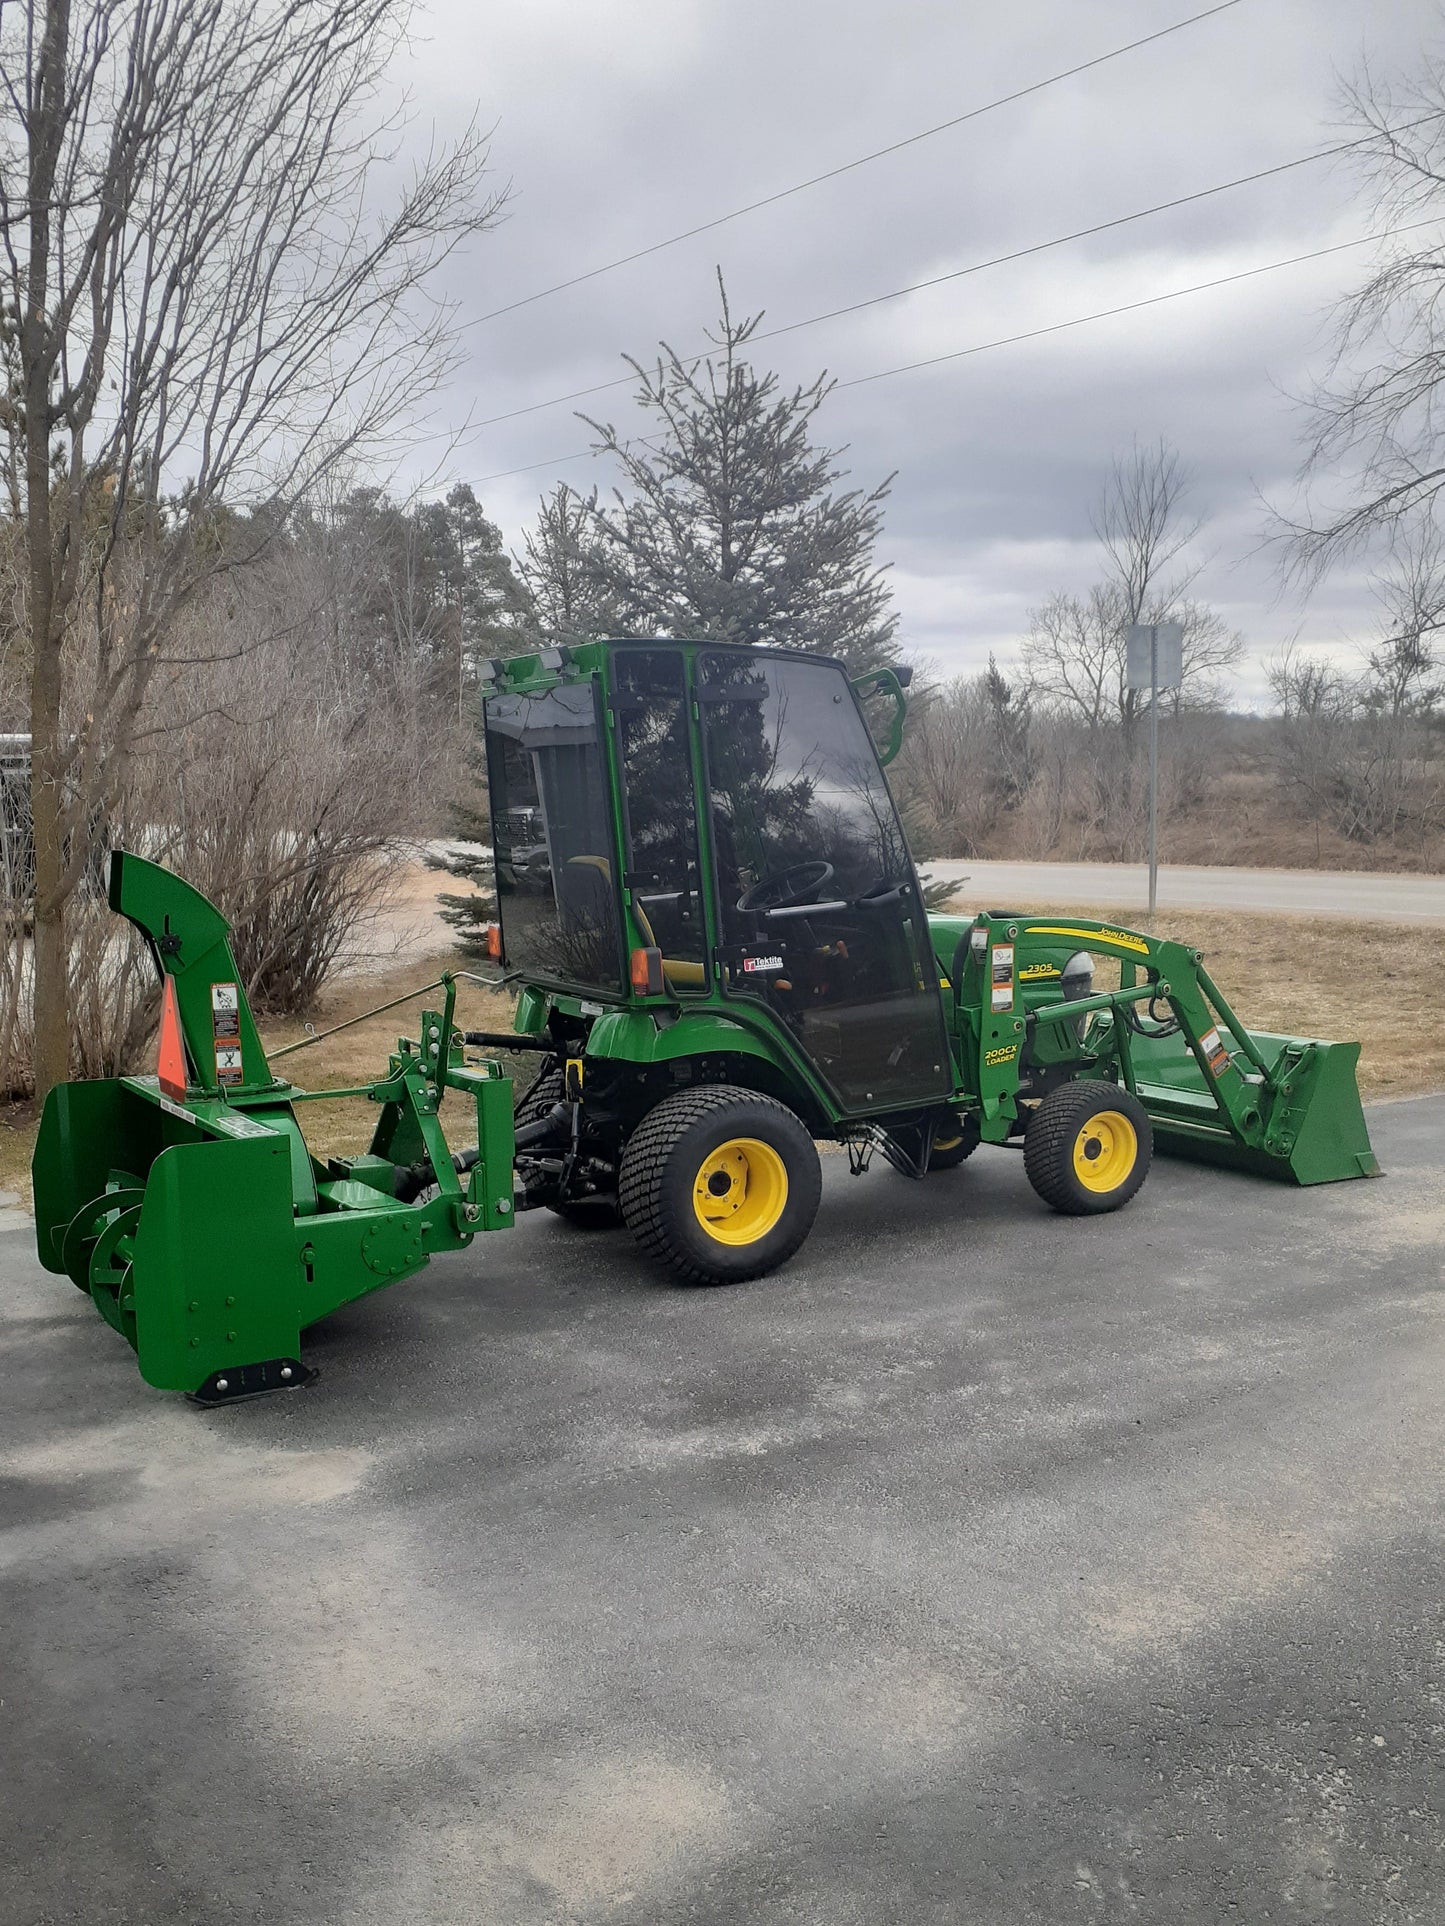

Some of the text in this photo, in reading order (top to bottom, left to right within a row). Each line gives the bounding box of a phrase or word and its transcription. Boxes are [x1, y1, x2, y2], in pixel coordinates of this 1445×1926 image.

[1097, 927, 1144, 945] JOHN DEERE
[755, 956, 783, 966] Tektite
[1027, 963, 1053, 973] 2305
[985, 1044, 1018, 1060] 200CX
[986, 1053, 1015, 1066] LOADER
